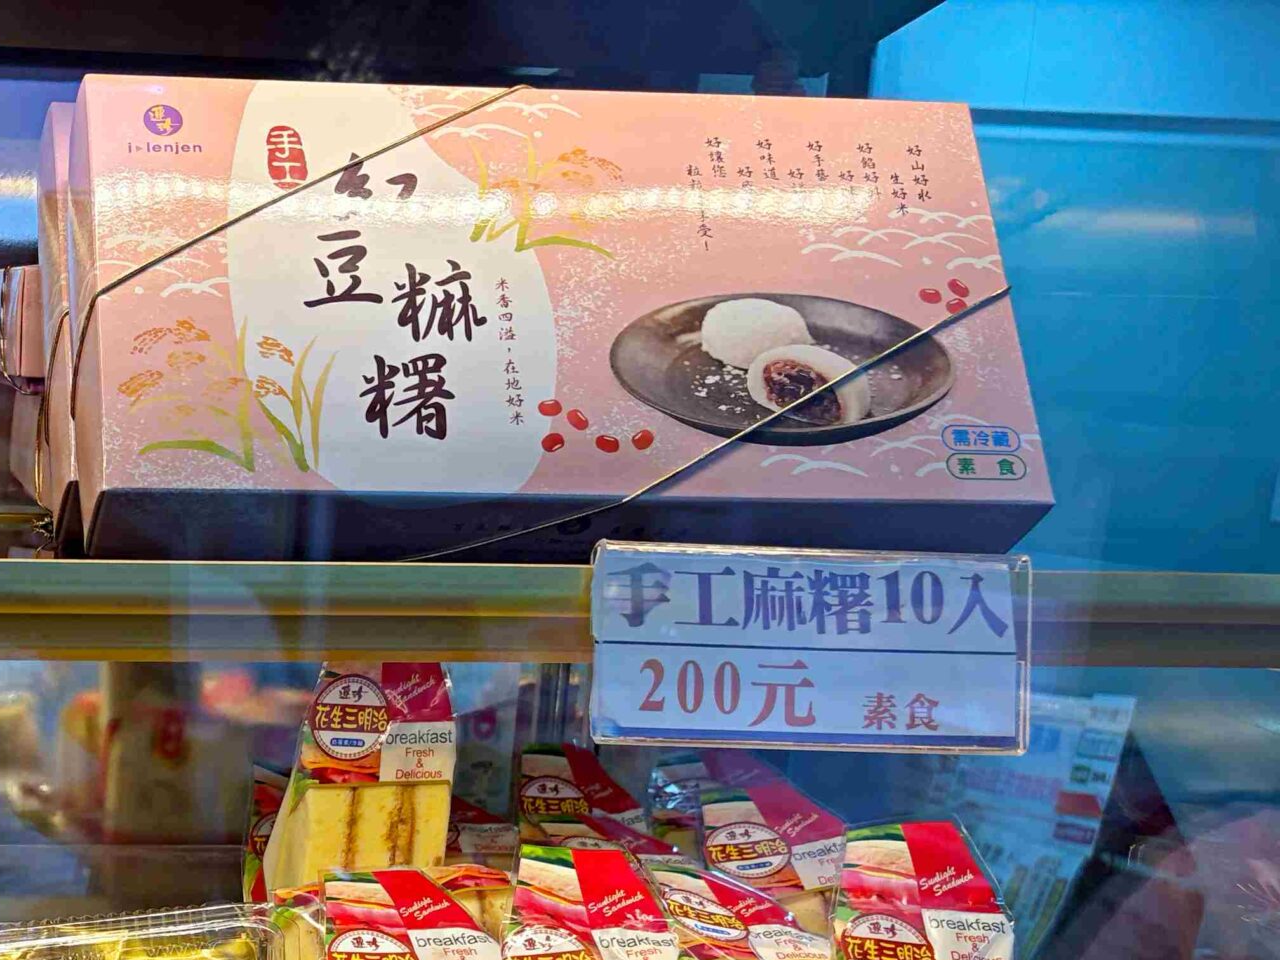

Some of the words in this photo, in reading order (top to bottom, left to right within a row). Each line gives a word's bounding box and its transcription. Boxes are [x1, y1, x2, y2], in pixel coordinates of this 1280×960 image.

[267, 129, 305, 184] 手工
[907, 145, 932, 202] 好山好水
[890, 173, 909, 216] 生好米
[607, 561, 1009, 639] 手工麻糬10入
[638, 658, 817, 728] 200元
[861, 691, 941, 732] 素食
[315, 705, 388, 732] 花生三明治
[386, 729, 453, 745] breakfast
[405, 748, 434, 757] Fresh
[395, 769, 443, 780] Delicious
[708, 838, 788, 862] 花生三明治
[932, 869, 974, 896] Sandwich
[412, 900, 450, 920] Sandwich
[602, 892, 645, 917] Sandwich
[928, 916, 1005, 933] breakfast
[416, 932, 492, 948] breakfast
[599, 936, 676, 949] breakfast
[956, 932, 990, 944] Fresh
[443, 947, 477, 956] Fresh
[776, 951, 828, 960] Delicious
